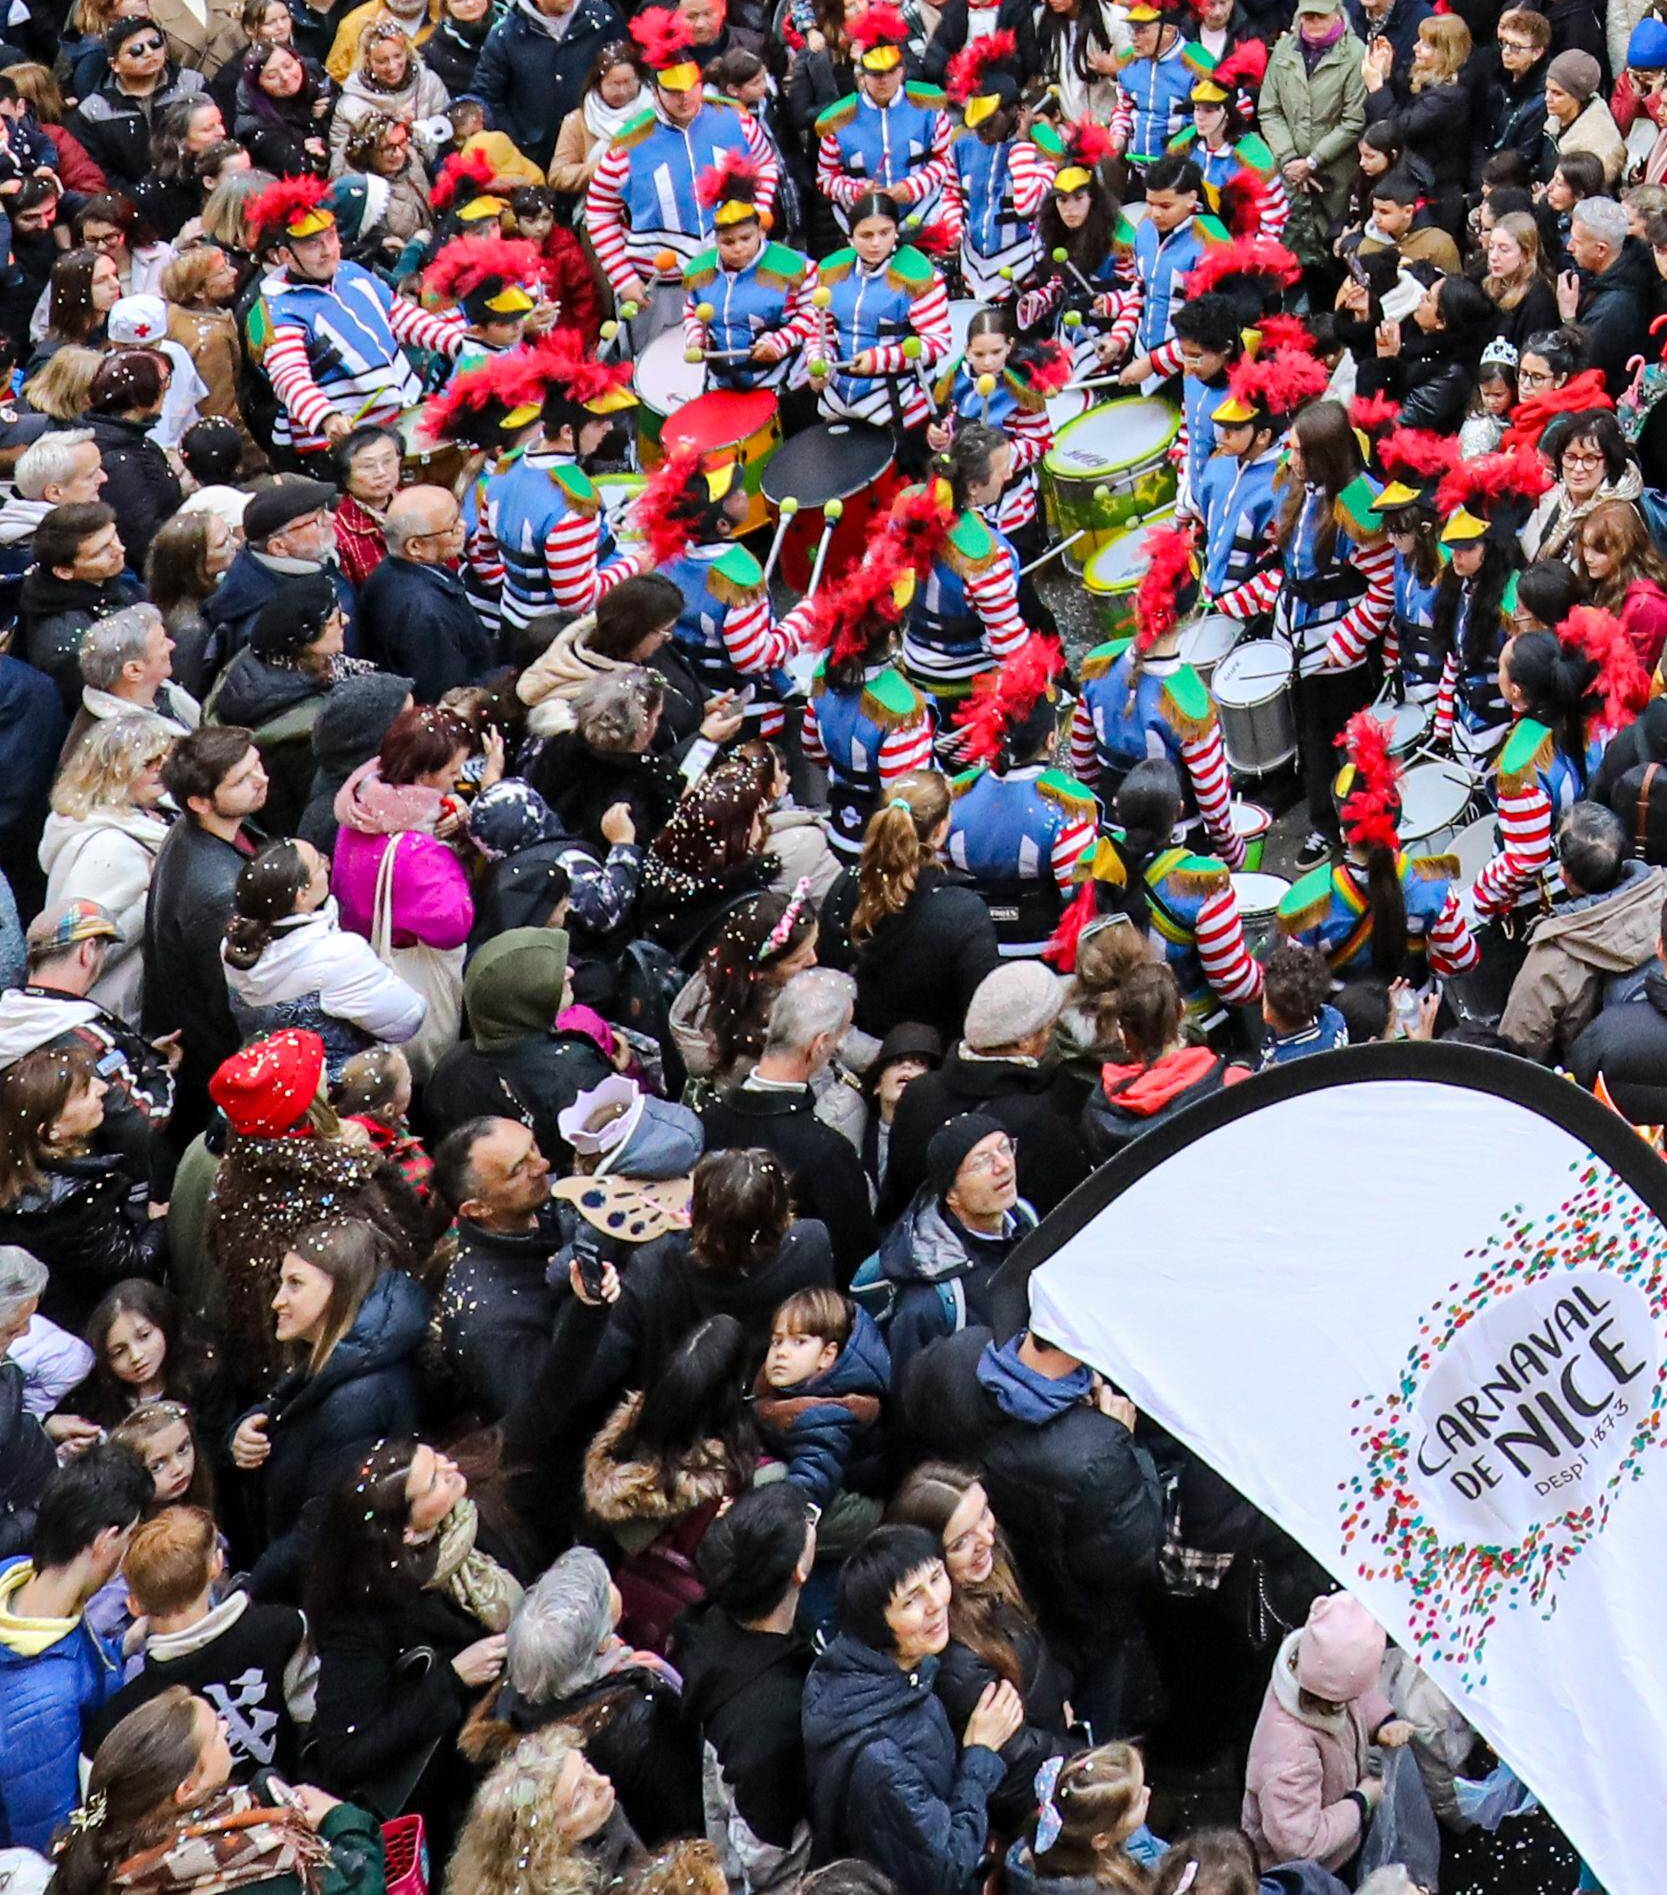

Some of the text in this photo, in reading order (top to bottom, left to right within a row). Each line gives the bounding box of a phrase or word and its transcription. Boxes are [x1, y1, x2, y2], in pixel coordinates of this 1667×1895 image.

[1415, 1284, 1613, 1478] CARNAVAL
[1448, 1317, 1648, 1501] DE NICE
